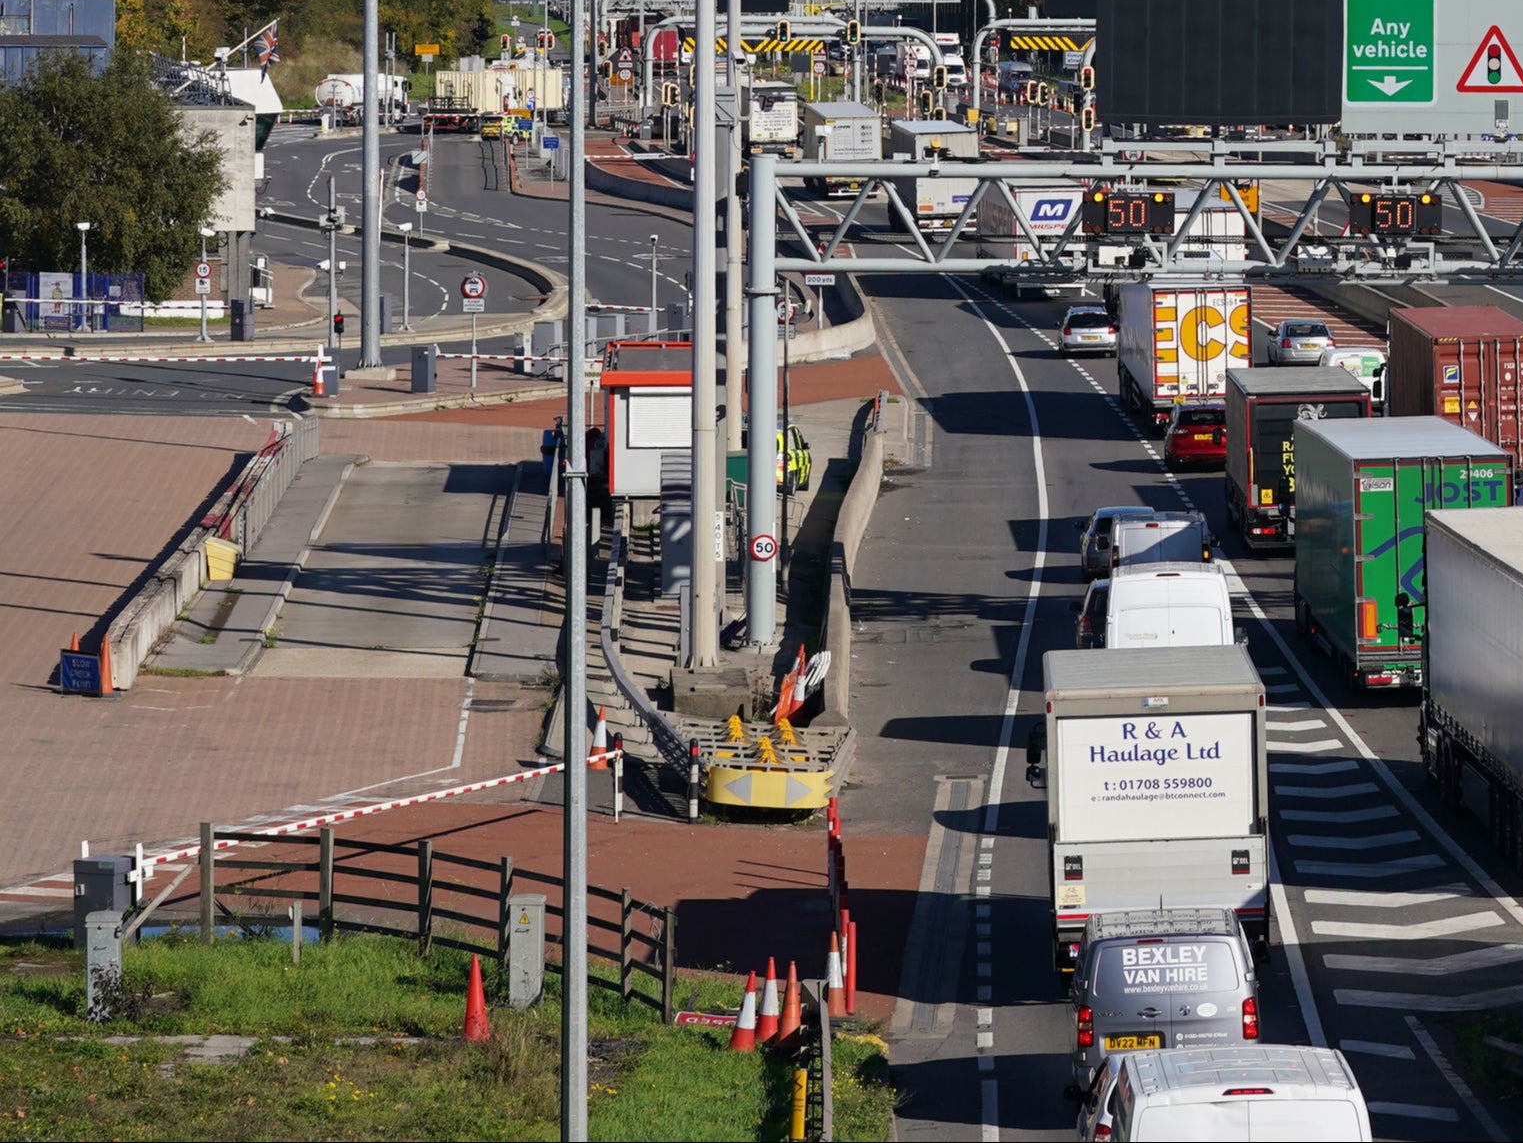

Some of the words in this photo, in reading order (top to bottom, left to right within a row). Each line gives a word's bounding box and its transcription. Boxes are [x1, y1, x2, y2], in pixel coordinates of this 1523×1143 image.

[1370, 17, 1411, 39] Any
[1352, 41, 1428, 58] vehicle
[1109, 199, 1146, 227] 50
[1377, 200, 1413, 228] 50
[199, 266, 208, 274] 15
[1155, 304, 1248, 362] ECS
[1414, 480, 1503, 504] JOST
[756, 542, 774, 553] 50
[1122, 722, 1138, 740] R
[1145, 721, 1162, 739] &
[1171, 721, 1187, 739] A
[1089, 743, 1179, 765] Haulage
[1186, 741, 1221, 760] Ltd
[1119, 779, 1160, 790] 01708
[1163, 777, 1213, 789] 559800
[1102, 791, 1226, 802] randahaulage@btconnect.com
[1122, 945, 1206, 966] BEXLEY
[1124, 969, 1160, 985] VAN
[1165, 967, 1208, 983] HIRE
[1123, 983, 1208, 994] www.bexleyvanhire.co.uk
[1109, 1038, 1134, 1049] DV22
